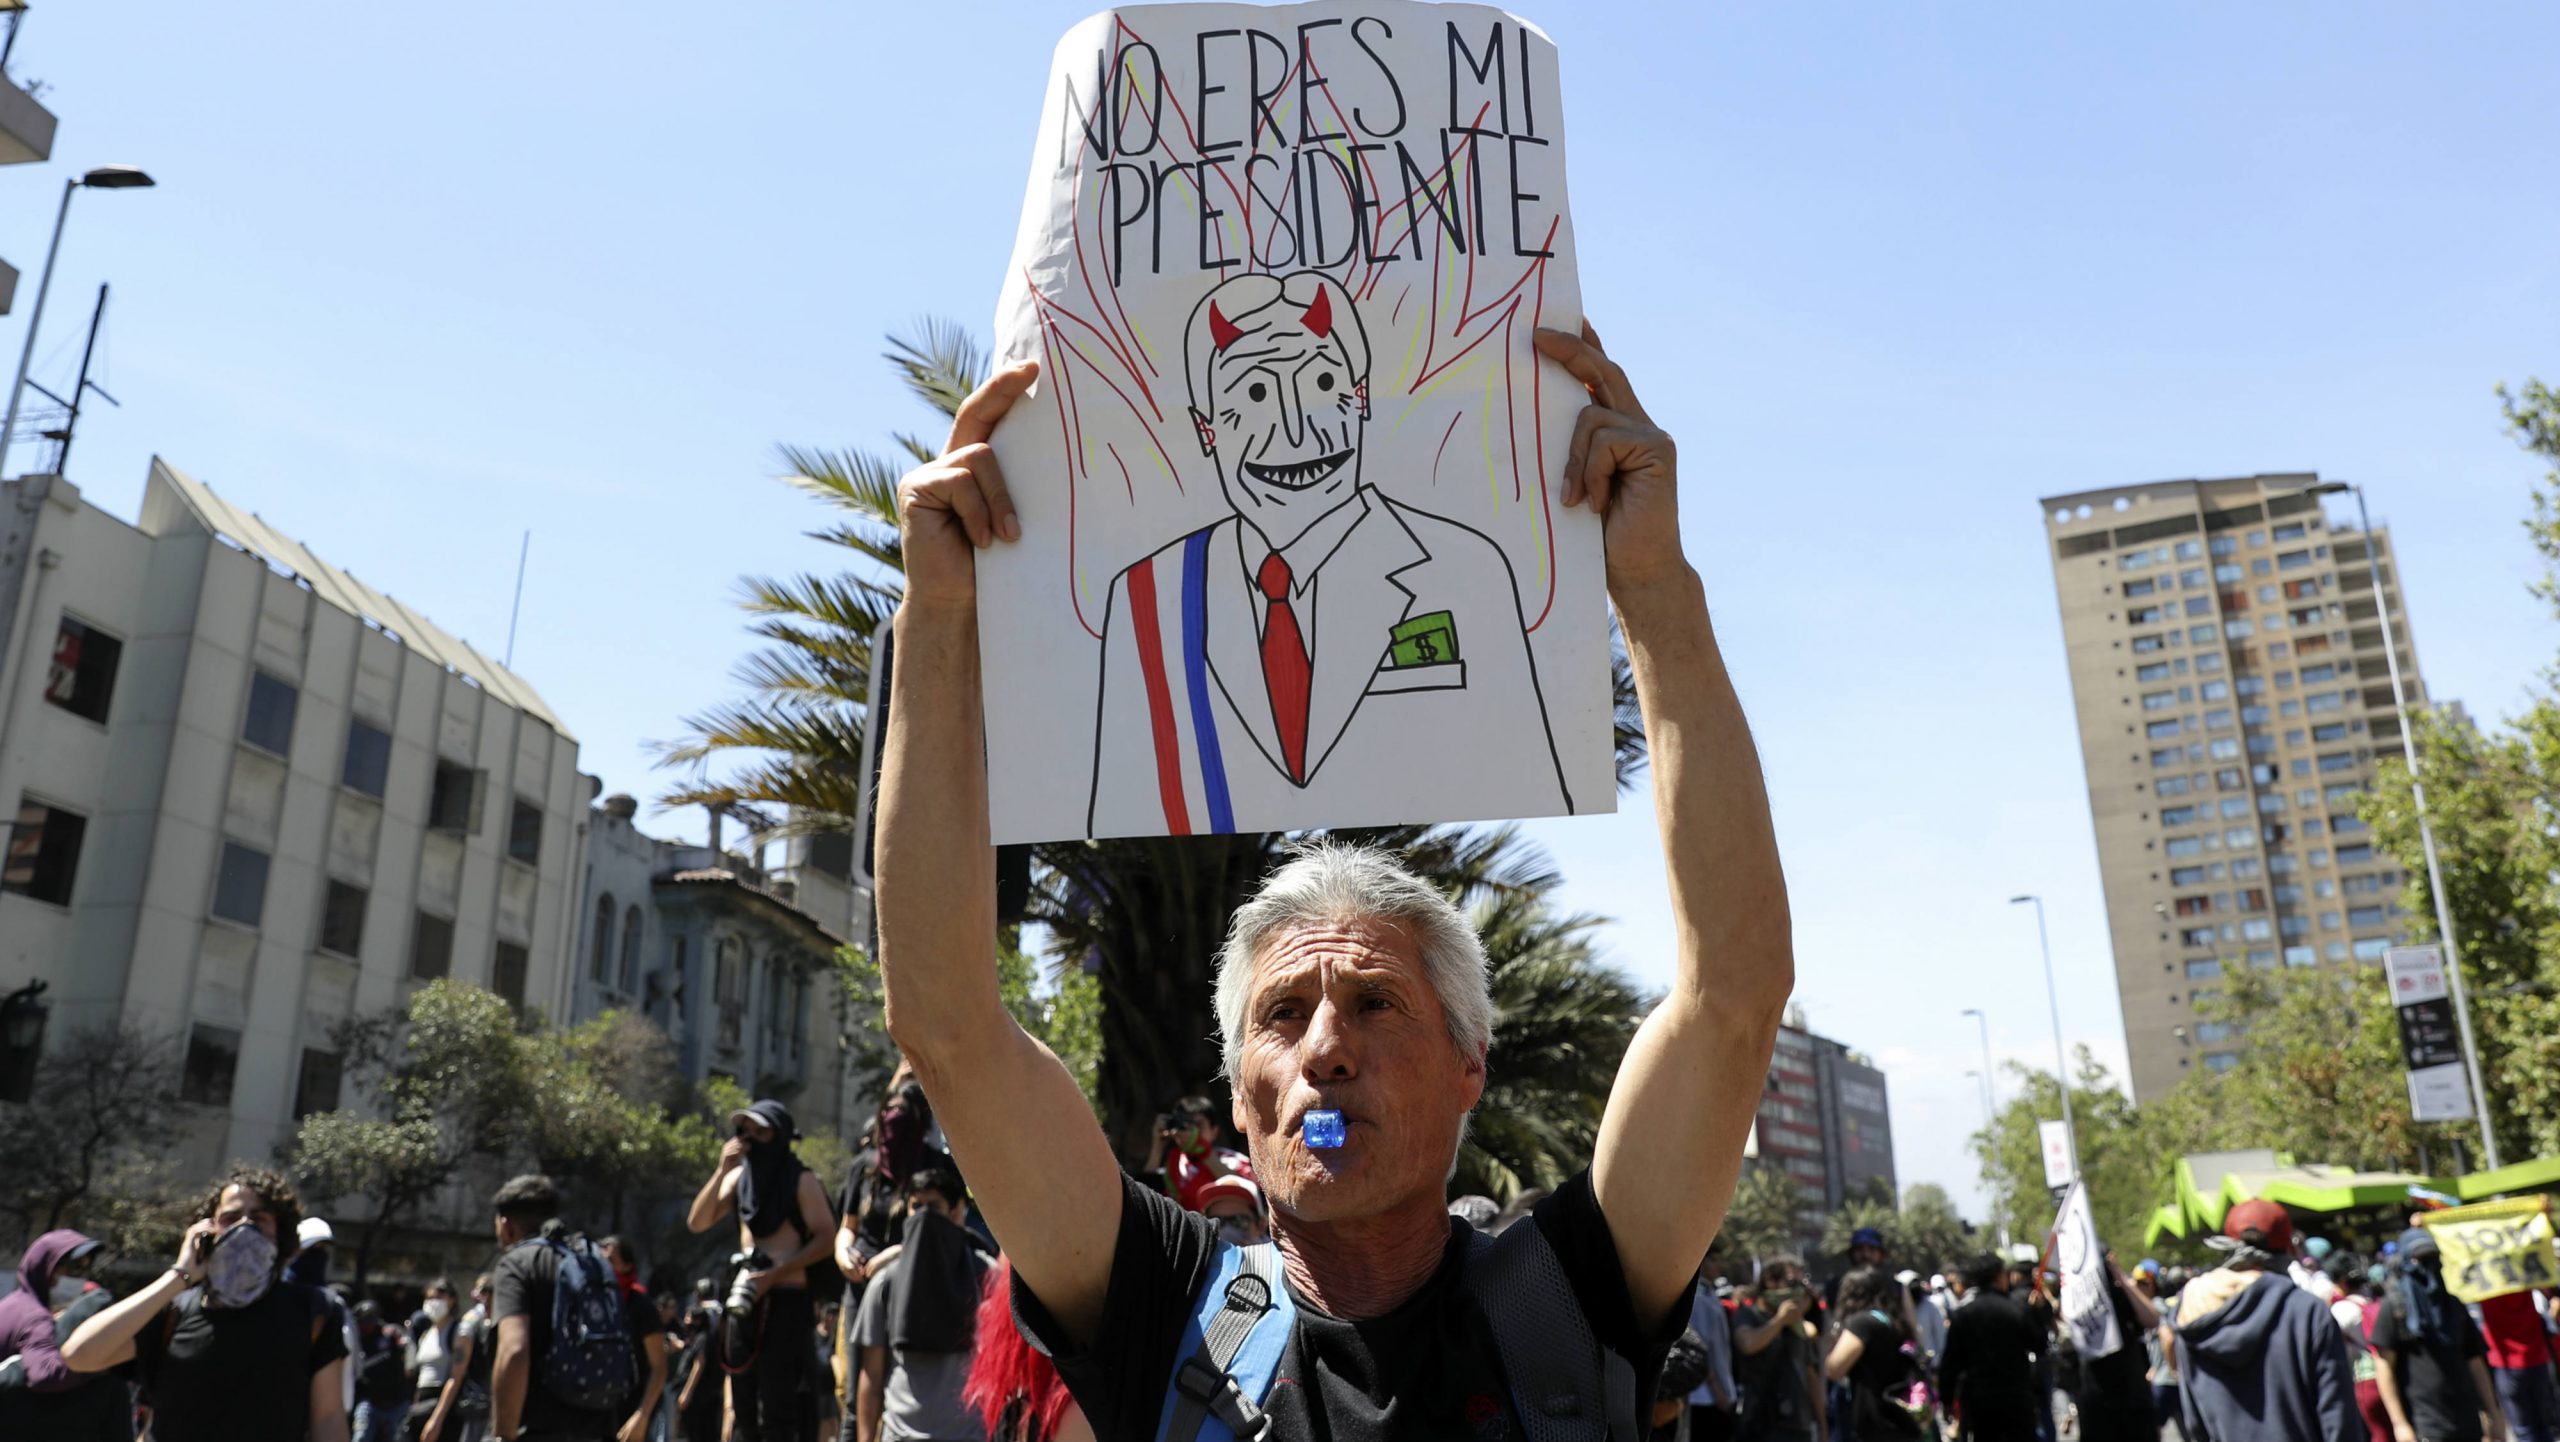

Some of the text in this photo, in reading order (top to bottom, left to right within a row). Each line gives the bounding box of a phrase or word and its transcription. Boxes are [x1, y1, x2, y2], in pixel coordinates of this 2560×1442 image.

[1059, 16, 1536, 168] NO ERES MI
